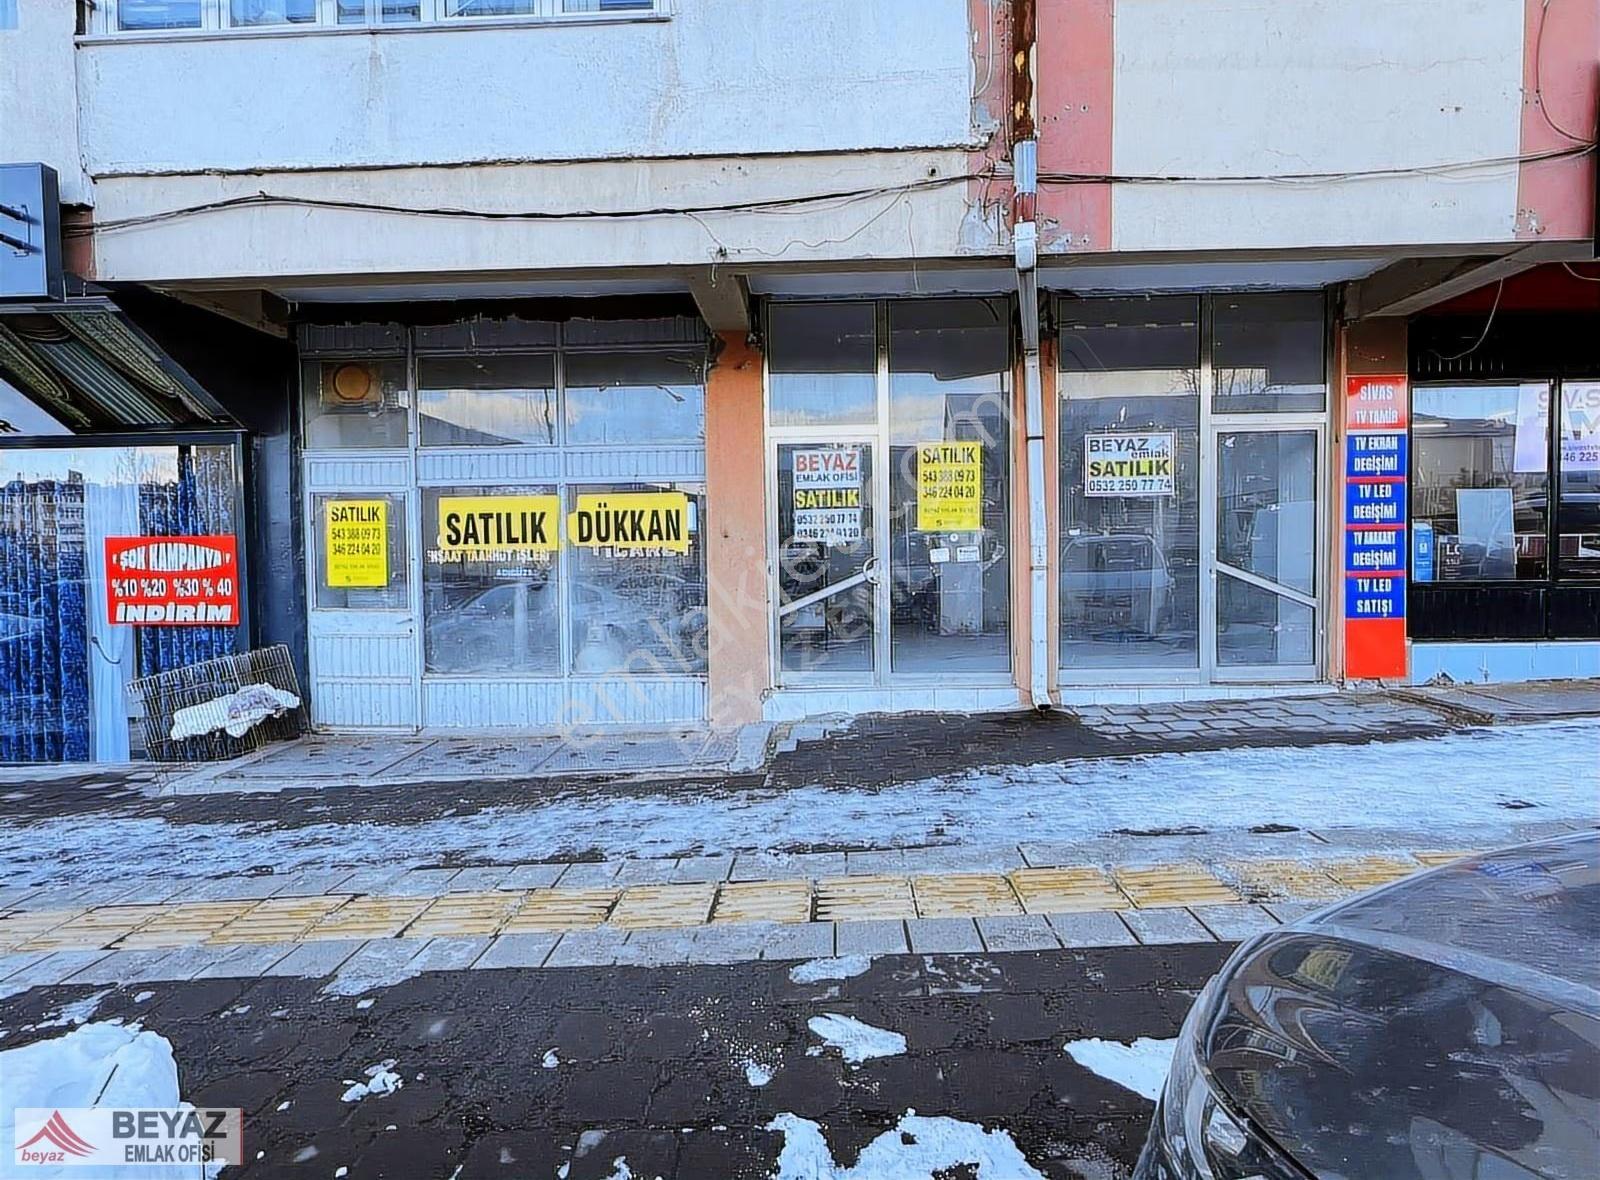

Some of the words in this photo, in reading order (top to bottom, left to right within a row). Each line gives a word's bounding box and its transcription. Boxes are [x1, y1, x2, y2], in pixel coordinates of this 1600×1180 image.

[1360, 383, 1393, 400] SİVAS
[1356, 409, 1367, 424] TV
[1090, 438, 1149, 452] BEYAZ
[1355, 437, 1366, 450] TV
[1369, 436, 1397, 450] EKRAN
[923, 447, 975, 464] SATILIK
[1131, 448, 1169, 459] emlak
[1579, 452, 1599, 462] 225
[796, 453, 857, 472] BEYAZ
[1090, 460, 1169, 477] SATILIK
[796, 473, 829, 483] EMLAK
[923, 470, 937, 482] 543
[954, 470, 964, 482] 09
[966, 470, 975, 482] 73
[923, 486, 937, 498] 346
[954, 486, 964, 498] 04
[966, 486, 975, 498] 20
[1089, 481, 1115, 491] 0532
[1118, 480, 1138, 491] 250
[1141, 480, 1153, 490] 77
[1159, 479, 1172, 489] 74
[1359, 484, 1371, 497] TV
[1374, 484, 1392, 497] LED
[796, 489, 859, 508] SATILIK
[331, 506, 380, 522] SATILIK
[797, 514, 817, 525] 0532
[819, 514, 835, 524] 250
[837, 514, 845, 524] 77
[446, 511, 547, 546] SATILIK
[578, 502, 681, 542] DÜKKAN
[331, 528, 345, 540] 543
[347, 528, 359, 540] 388
[361, 528, 370, 540] 09
[372, 528, 380, 540] 73
[1354, 531, 1363, 545] TV
[333, 543, 345, 555] 346
[347, 543, 359, 555] 224
[372, 543, 380, 555] 20
[120, 545, 145, 571] ŞOK
[149, 542, 222, 571] KAMPANYA
[112, 578, 137, 597] %10
[140, 578, 166, 597] %20
[172, 578, 199, 597] %30
[1357, 579, 1370, 592] TV
[1373, 579, 1392, 592] LED
[116, 602, 231, 622] İNDİRİM
[1357, 599, 1392, 617] SATIŞI
